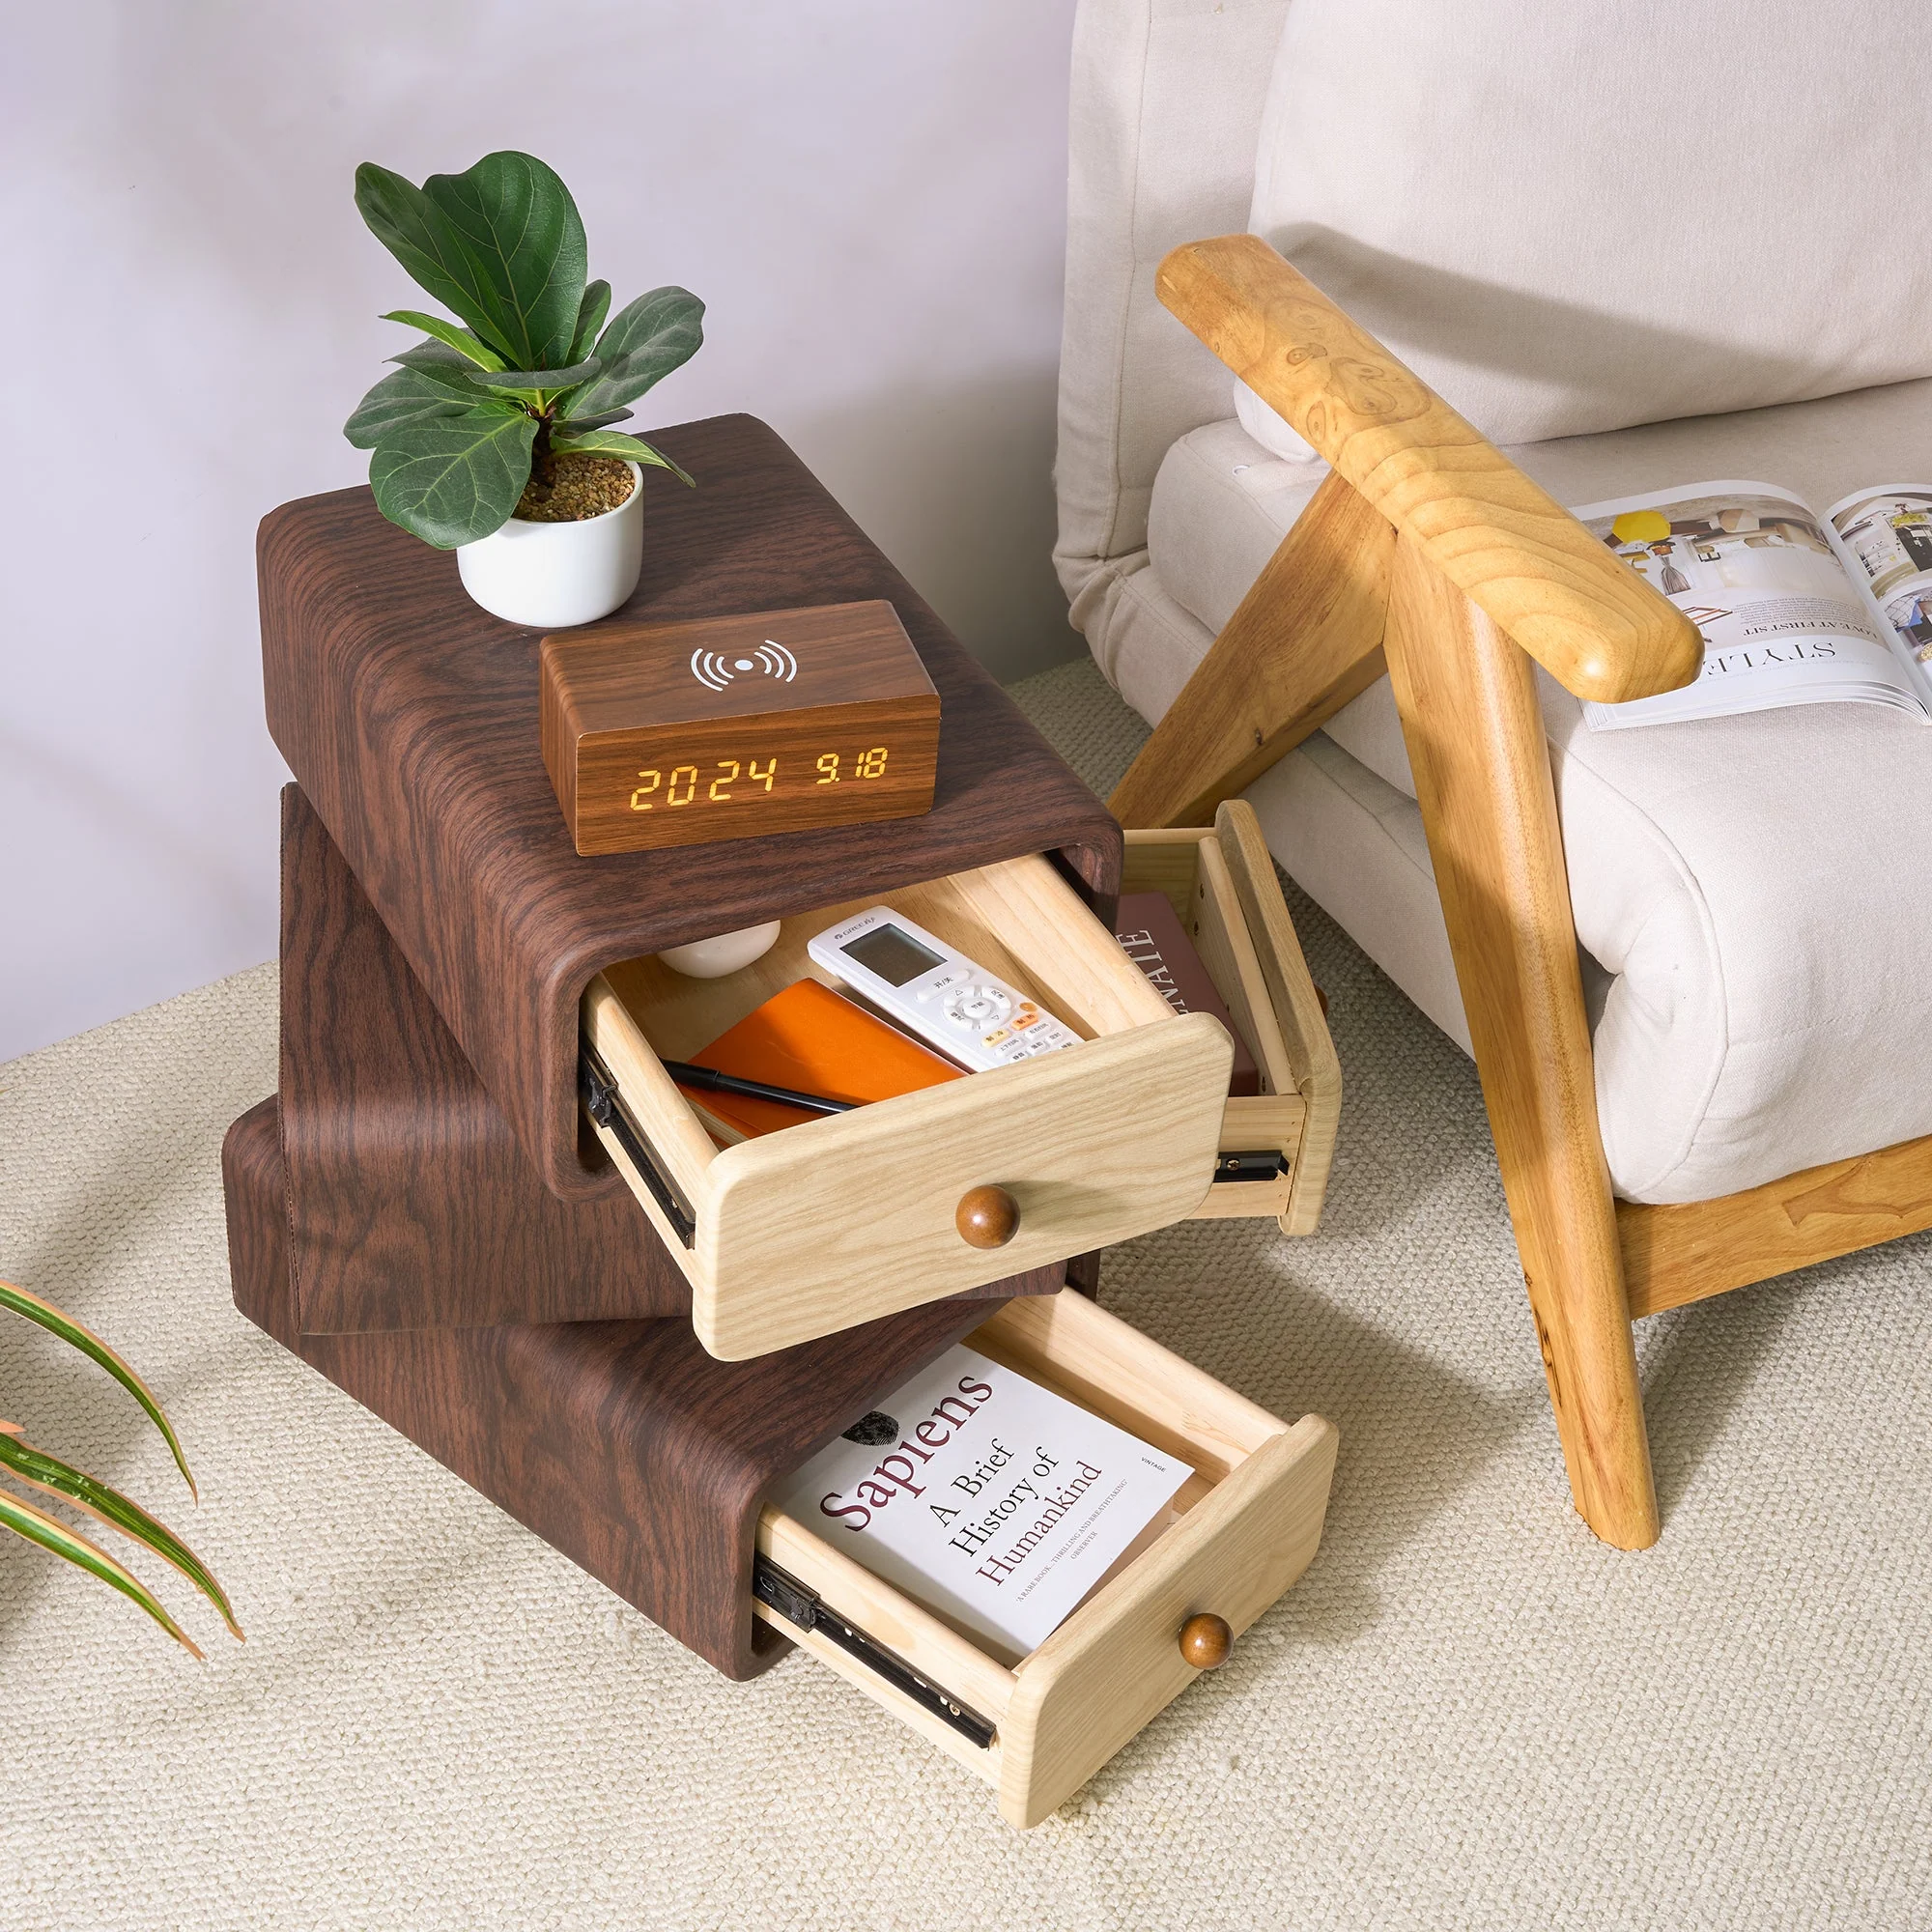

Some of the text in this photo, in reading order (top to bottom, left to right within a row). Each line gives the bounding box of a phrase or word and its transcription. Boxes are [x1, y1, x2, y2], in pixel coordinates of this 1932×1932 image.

[1743, 626, 1768, 636] SIT
[1771, 621, 1815, 631] FIRST
[1703, 641, 1835, 675] STYLE
[630, 747, 889, 810] 2024 9.18
[819, 1376, 993, 1532] Sapiens
[929, 1437, 1015, 1527] A Brief
[1141, 1457, 1167, 1473] VINTAGE
[949, 1446, 1060, 1557] History of
[975, 1460, 1102, 1586] Humankind
[1021, 1581, 1037, 1597] RARE
[1079, 1520, 1092, 1534] AND
[1070, 1531, 1098, 1560] OBSERVER
